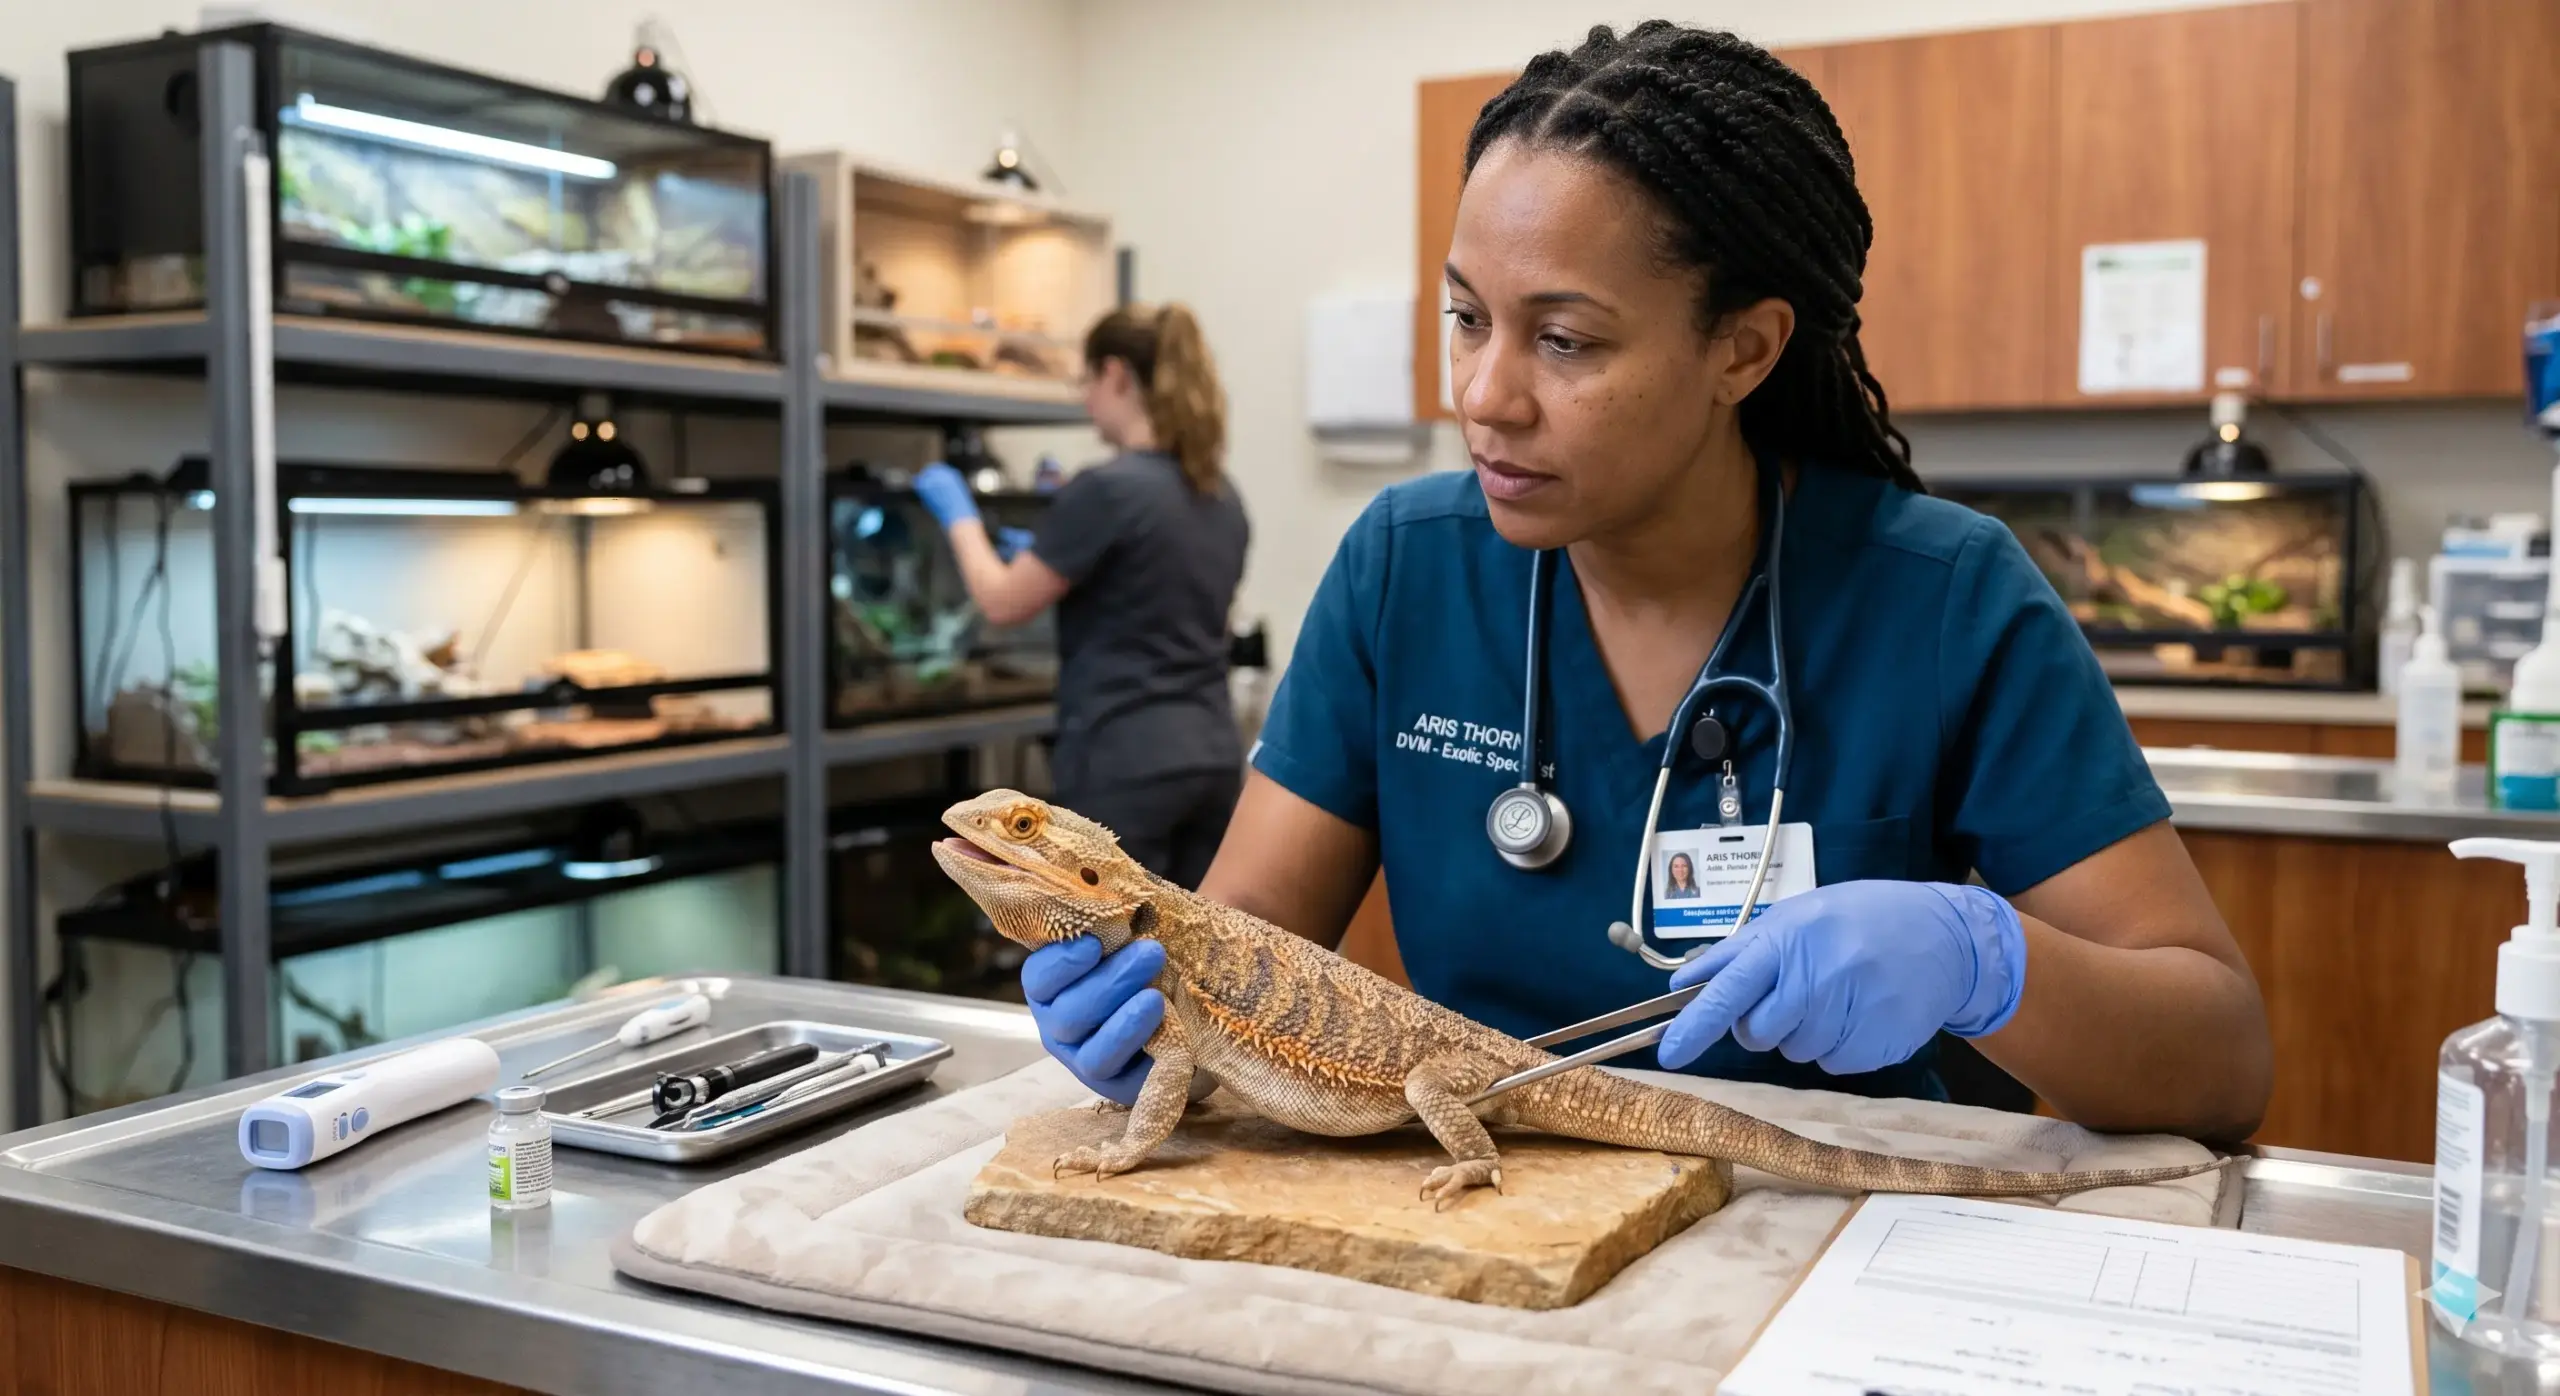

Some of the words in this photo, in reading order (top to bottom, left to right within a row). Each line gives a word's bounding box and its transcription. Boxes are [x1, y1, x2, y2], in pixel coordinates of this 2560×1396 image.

[1413, 713, 1459, 738] ARIS
[1463, 722, 1543, 752] THORN
[1396, 732, 1432, 753] DVM
[1441, 742, 1483, 764] Exotic
[1485, 751, 1555, 779] Specst
[1706, 853, 1728, 862] ARIS
